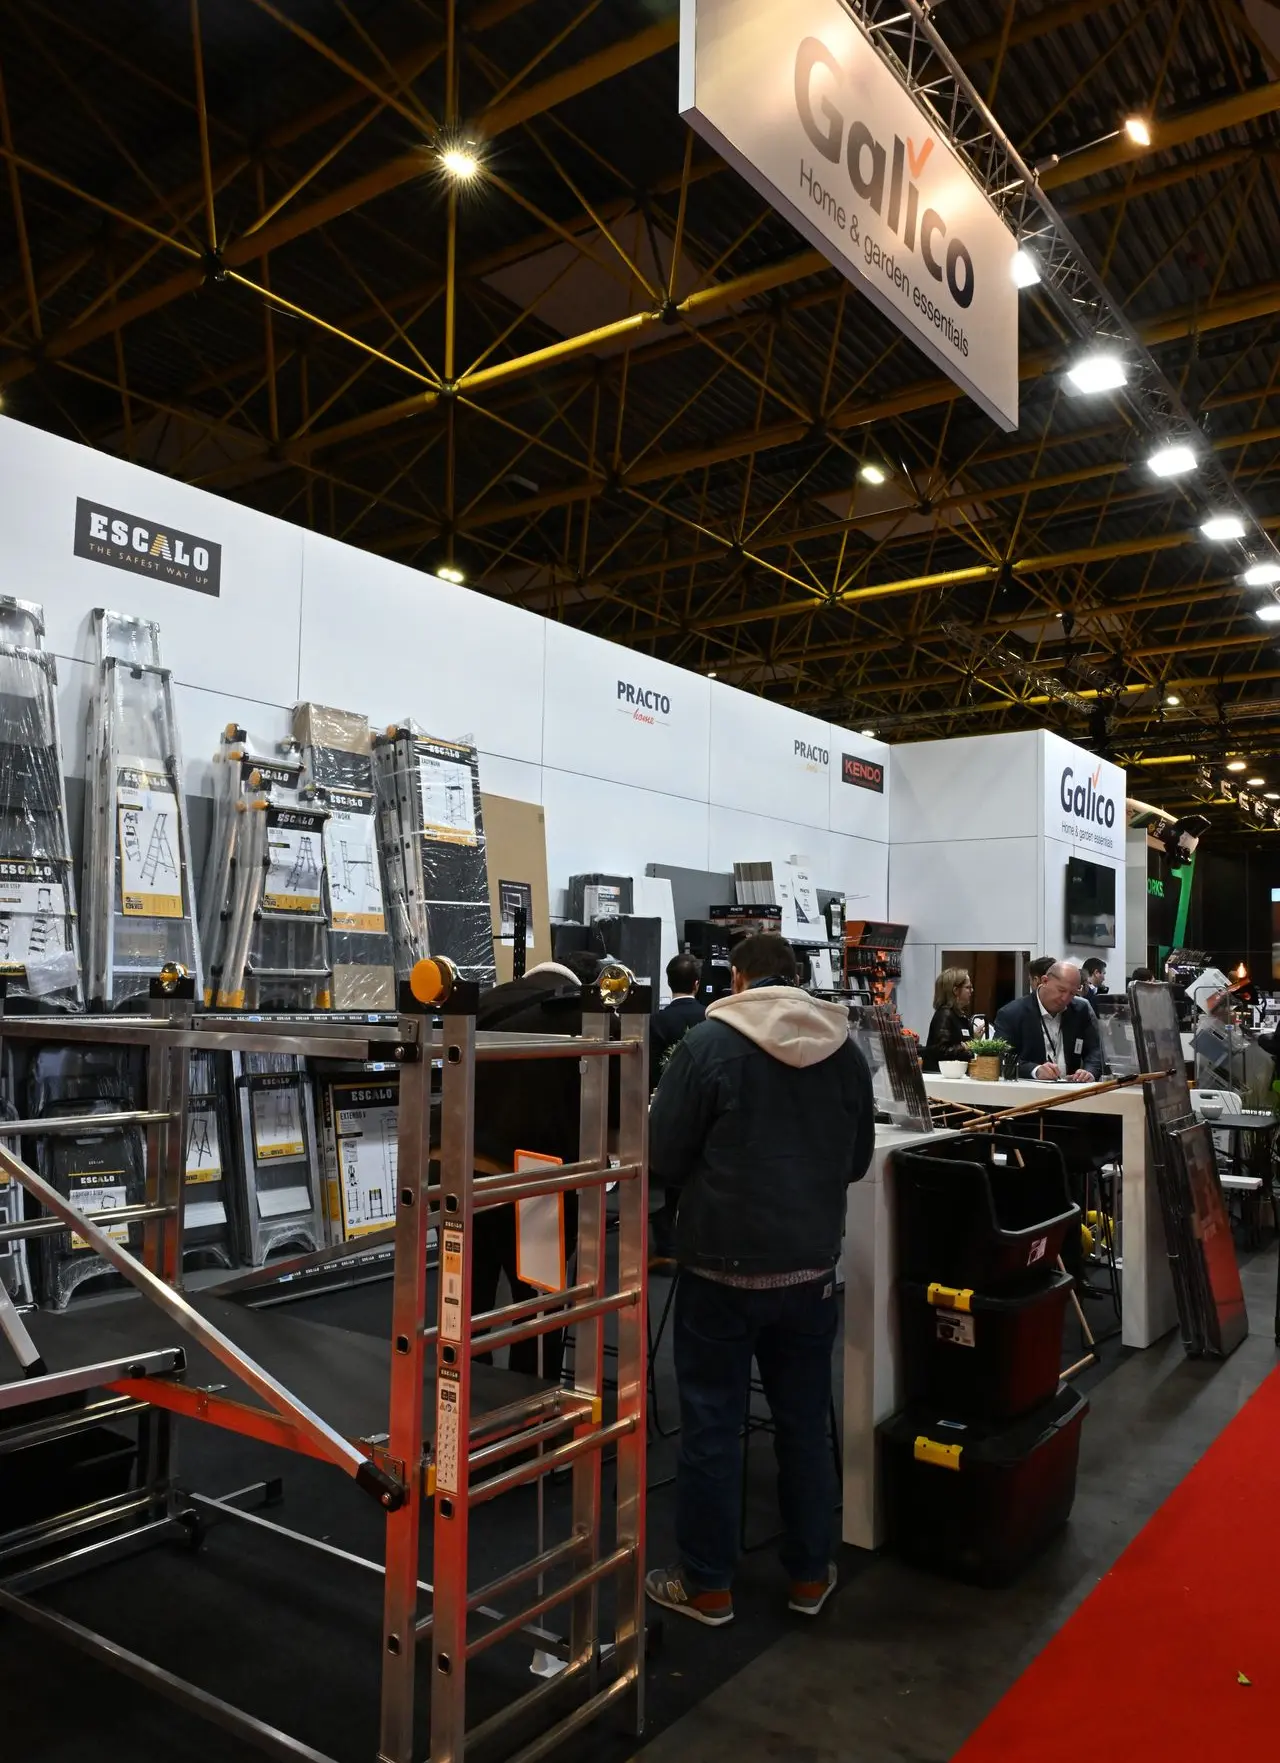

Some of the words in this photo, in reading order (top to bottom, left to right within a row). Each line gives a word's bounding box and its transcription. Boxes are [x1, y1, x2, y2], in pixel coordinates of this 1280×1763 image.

[794, 36, 975, 309] Galico
[800, 159, 847, 231] Home
[850, 214, 861, 248] &
[864, 235, 911, 298] garden
[913, 287, 969, 358] essentials
[89, 512, 209, 571] ESCALO
[89, 543, 111, 557] THE
[118, 552, 160, 571] SAFEST
[166, 566, 189, 579] WAY
[195, 575, 209, 585] UP
[617, 680, 670, 714] PRACTO
[633, 708, 654, 725] home
[794, 739, 829, 765] PRACTO
[845, 759, 881, 783] KENDO
[1060, 766, 1115, 829] Galico
[277, 813, 314, 826] ESCALO
[1153, 817, 1167, 839] FAST
[1061, 821, 1075, 836] Home
[1079, 829, 1094, 842] garden
[1094, 834, 1113, 849] essentials
[1, 864, 52, 876] ESCALO
[351, 1088, 393, 1101] ESCALO
[80, 1175, 115, 1184] ESCALO
